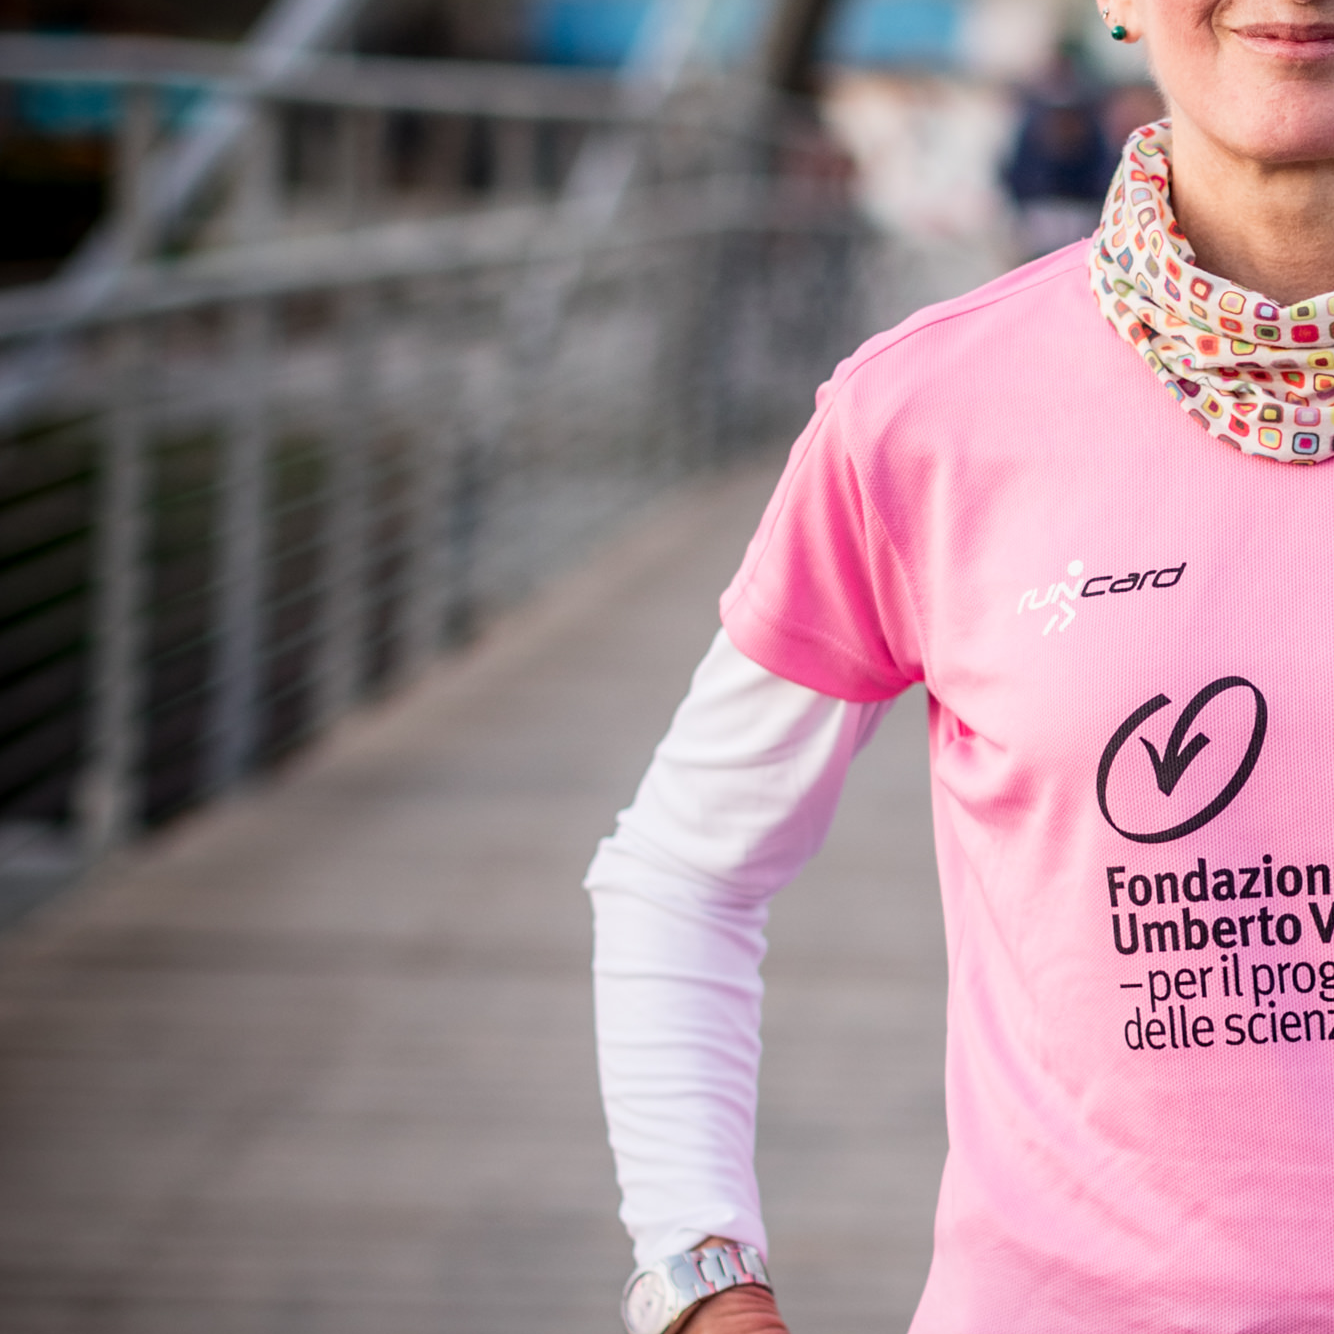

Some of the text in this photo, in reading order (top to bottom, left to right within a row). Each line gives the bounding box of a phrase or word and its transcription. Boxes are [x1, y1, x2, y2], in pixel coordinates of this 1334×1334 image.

[1112, 905, 1302, 955] Umberto
[1220, 953, 1244, 997] il
[1124, 1004, 1215, 1050] delle
